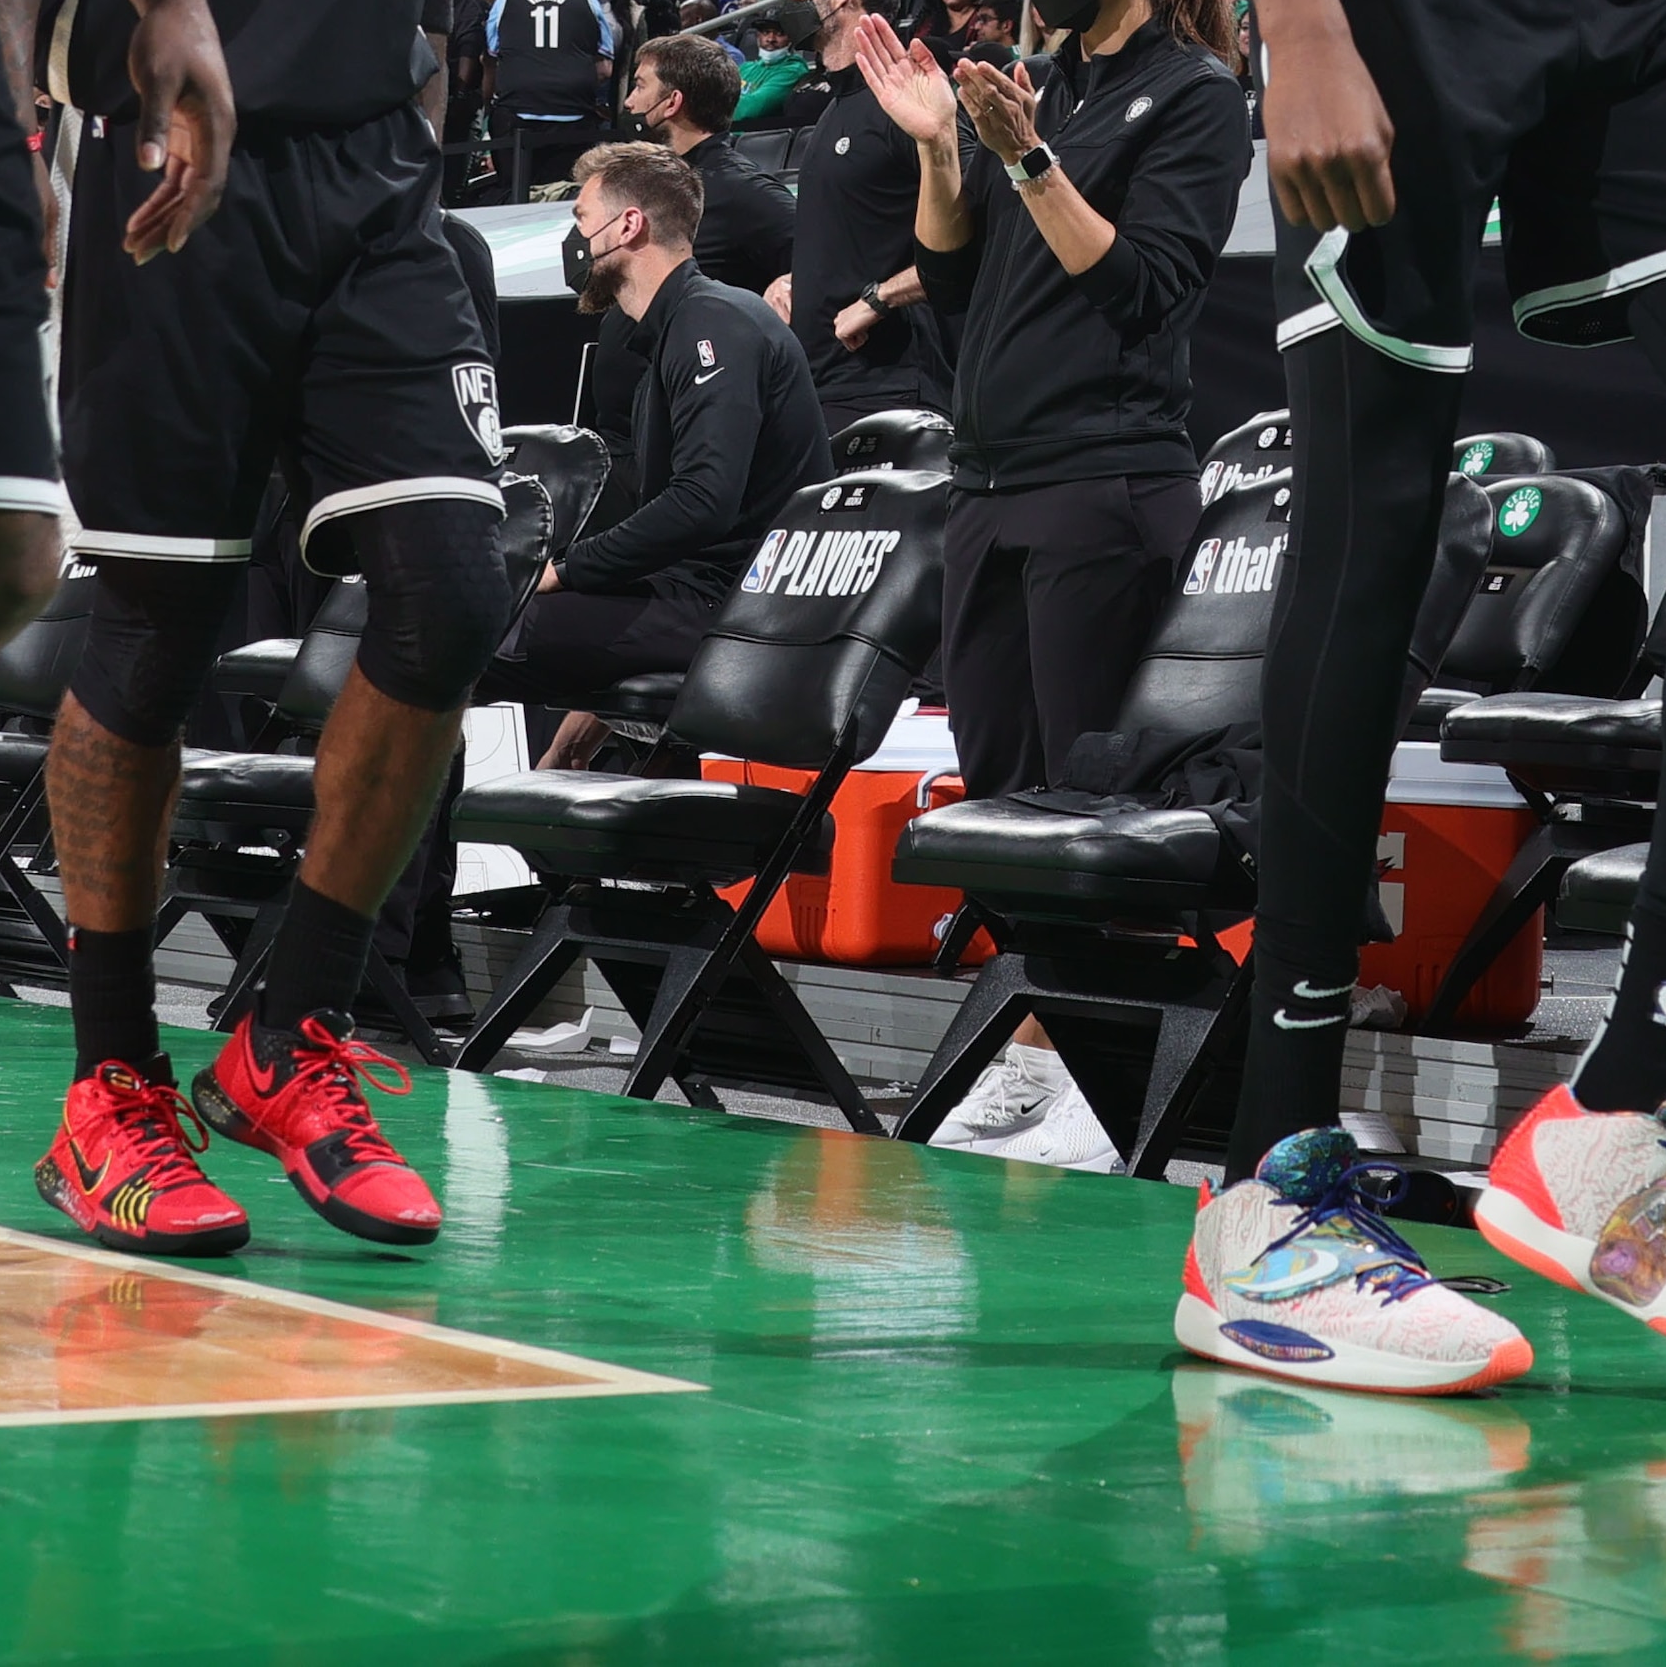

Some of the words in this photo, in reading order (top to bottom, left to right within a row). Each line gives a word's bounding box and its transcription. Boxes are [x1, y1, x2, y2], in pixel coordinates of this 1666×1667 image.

[530, 5, 560, 49] 11
[1464, 442, 1494, 460] CELTICS
[1505, 489, 1540, 510] CELTICS
[767, 529, 901, 597] PLAYOFFS
